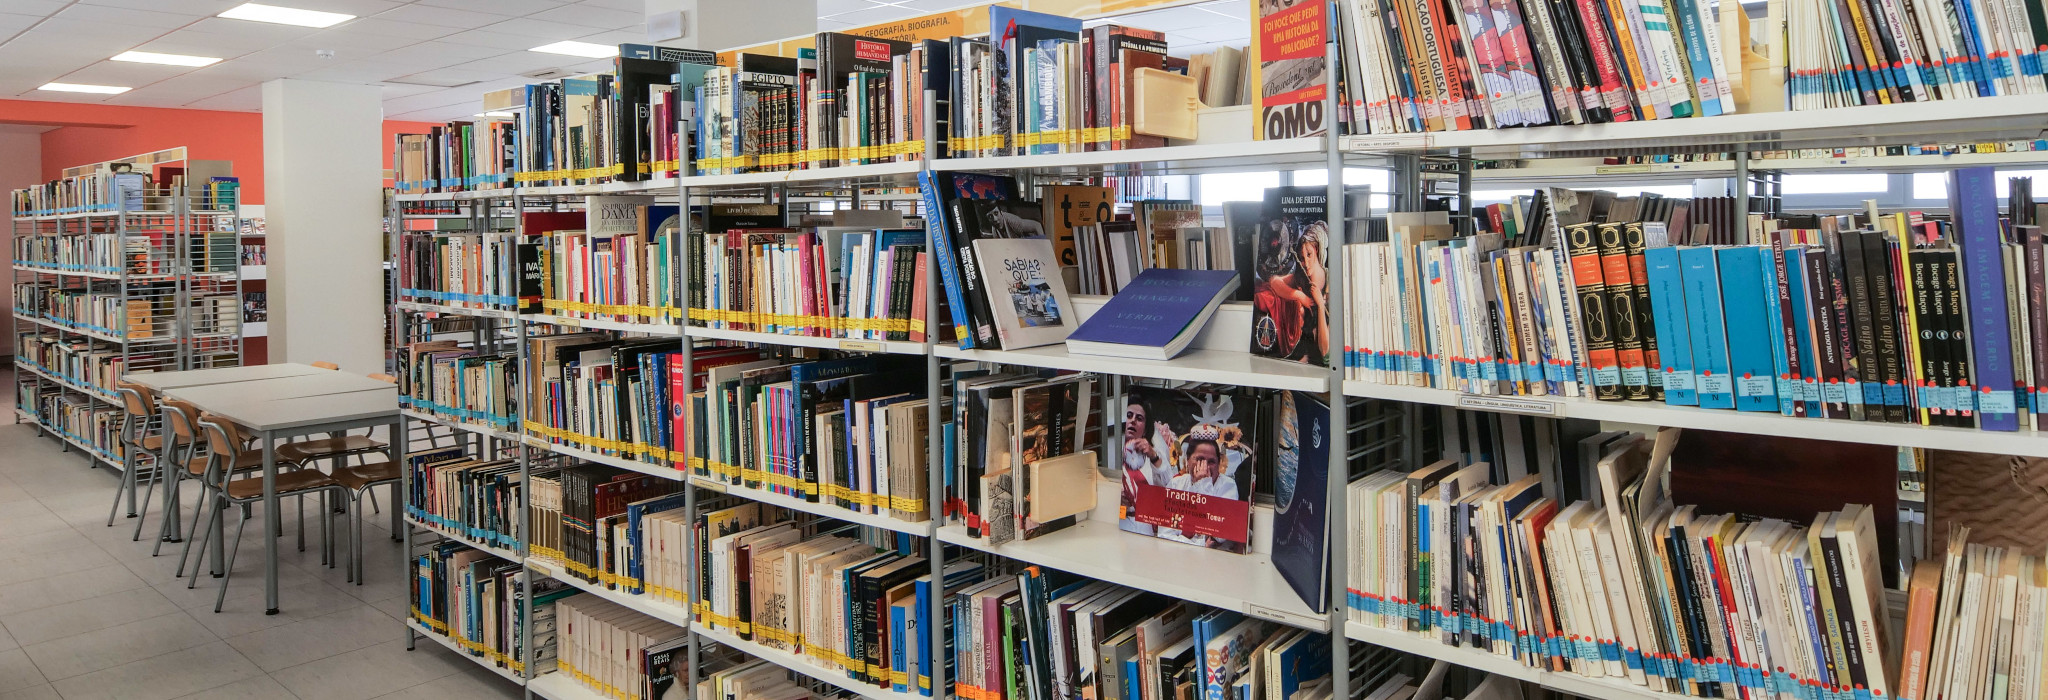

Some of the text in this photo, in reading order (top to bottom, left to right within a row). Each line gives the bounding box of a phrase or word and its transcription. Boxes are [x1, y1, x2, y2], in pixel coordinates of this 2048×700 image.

[865, 18, 950, 39] GEOGRAFIA. BIOGRAFIA.
[1264, 4, 1319, 33] FOI QUE PEDIU
[1311, 20, 1319, 31] DA
[1585, 0, 1614, 74] FERNANDO LOPES-GRAÇA
[1886, 12, 1905, 49] de Emoções
[856, 50, 890, 60] HUMANIDADE
[861, 42, 885, 51] HISTÓRIA
[1424, 28, 1447, 95] PORTUGUESA
[751, 73, 786, 85] EGIPTO
[1281, 195, 1327, 205] LIMA DE FREITAS
[920, 182, 960, 311] ATLAS DA HISTÓRIA DO MUNDO
[1773, 239, 1790, 300] JOSÉ JORGE LETRIA
[1969, 177, 1985, 225] BOCAGE
[1977, 250, 1990, 300] IMAGEM
[1985, 331, 1998, 371] VERBO
[1915, 263, 1928, 315] Bocage Maçon
[1930, 263, 1944, 315] Bocage Maçon
[1946, 262, 1960, 315] Bocage Maçon
[1518, 291, 1526, 310] TERRA
[1521, 312, 1528, 320] DA
[1523, 322, 1531, 345] HOMEM
[1820, 306, 1836, 363] ANTOLOGIA POÉTICA
[1860, 325, 1873, 353] Sadino
[1882, 324, 1895, 353] Sadino
[1927, 360, 1935, 376] Jorge
[1942, 361, 1951, 376] Jorge
[654, 393, 661, 405] XX
[1053, 412, 1061, 442] ILUSTRES
[1164, 488, 1207, 505] Tradição
[1206, 512, 1226, 523] Tomar
[1669, 587, 1688, 652] CÂNTICO PRIMAVERIL
[1723, 604, 1731, 626] ARDENTE
[836, 614, 844, 642] PORTUGAL
[1752, 619, 1761, 642] Antologia
[1826, 607, 1845, 669] POESIAS SADINAS
[1858, 619, 1876, 654] BESTIÁRIO
[1820, 634, 1828, 646] mota
[653, 652, 670, 660] CASAS
[653, 657, 670, 665] REAIS
